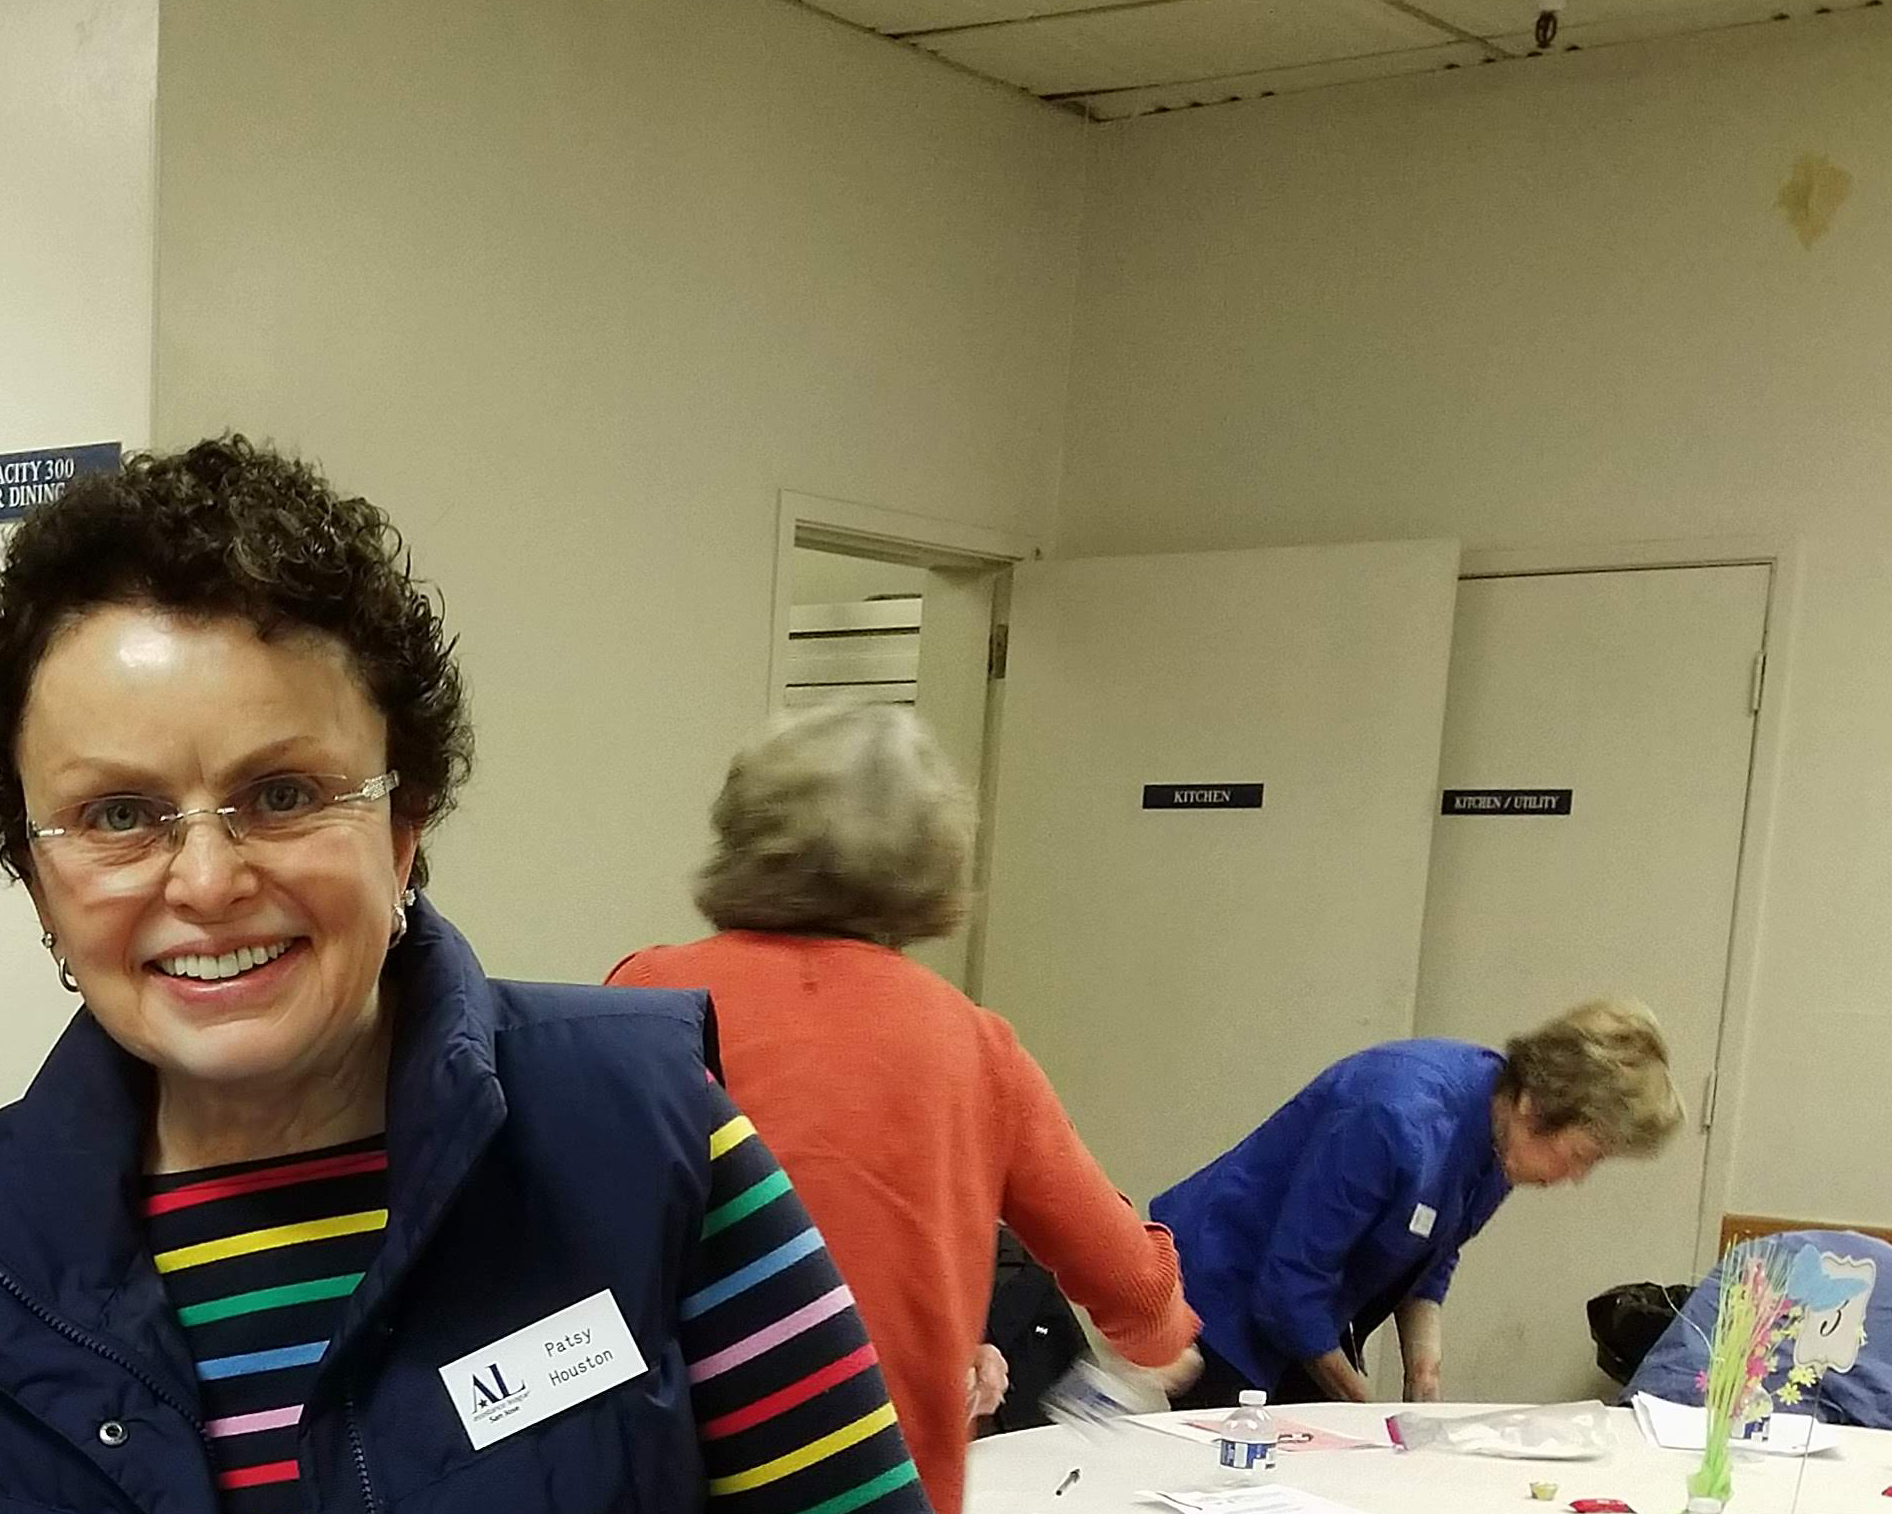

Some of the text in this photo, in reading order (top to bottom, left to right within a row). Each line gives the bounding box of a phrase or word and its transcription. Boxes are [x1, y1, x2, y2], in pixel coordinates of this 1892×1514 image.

[45, 458, 75, 480] 300
[1173, 790, 1232, 804] KITCHEN
[1454, 796, 1501, 809] KITCHEN
[1514, 796, 1560, 809] UTILITY
[544, 1328, 591, 1357] Patsy
[548, 1350, 614, 1387] Houston
[471, 1363, 526, 1414] AL
